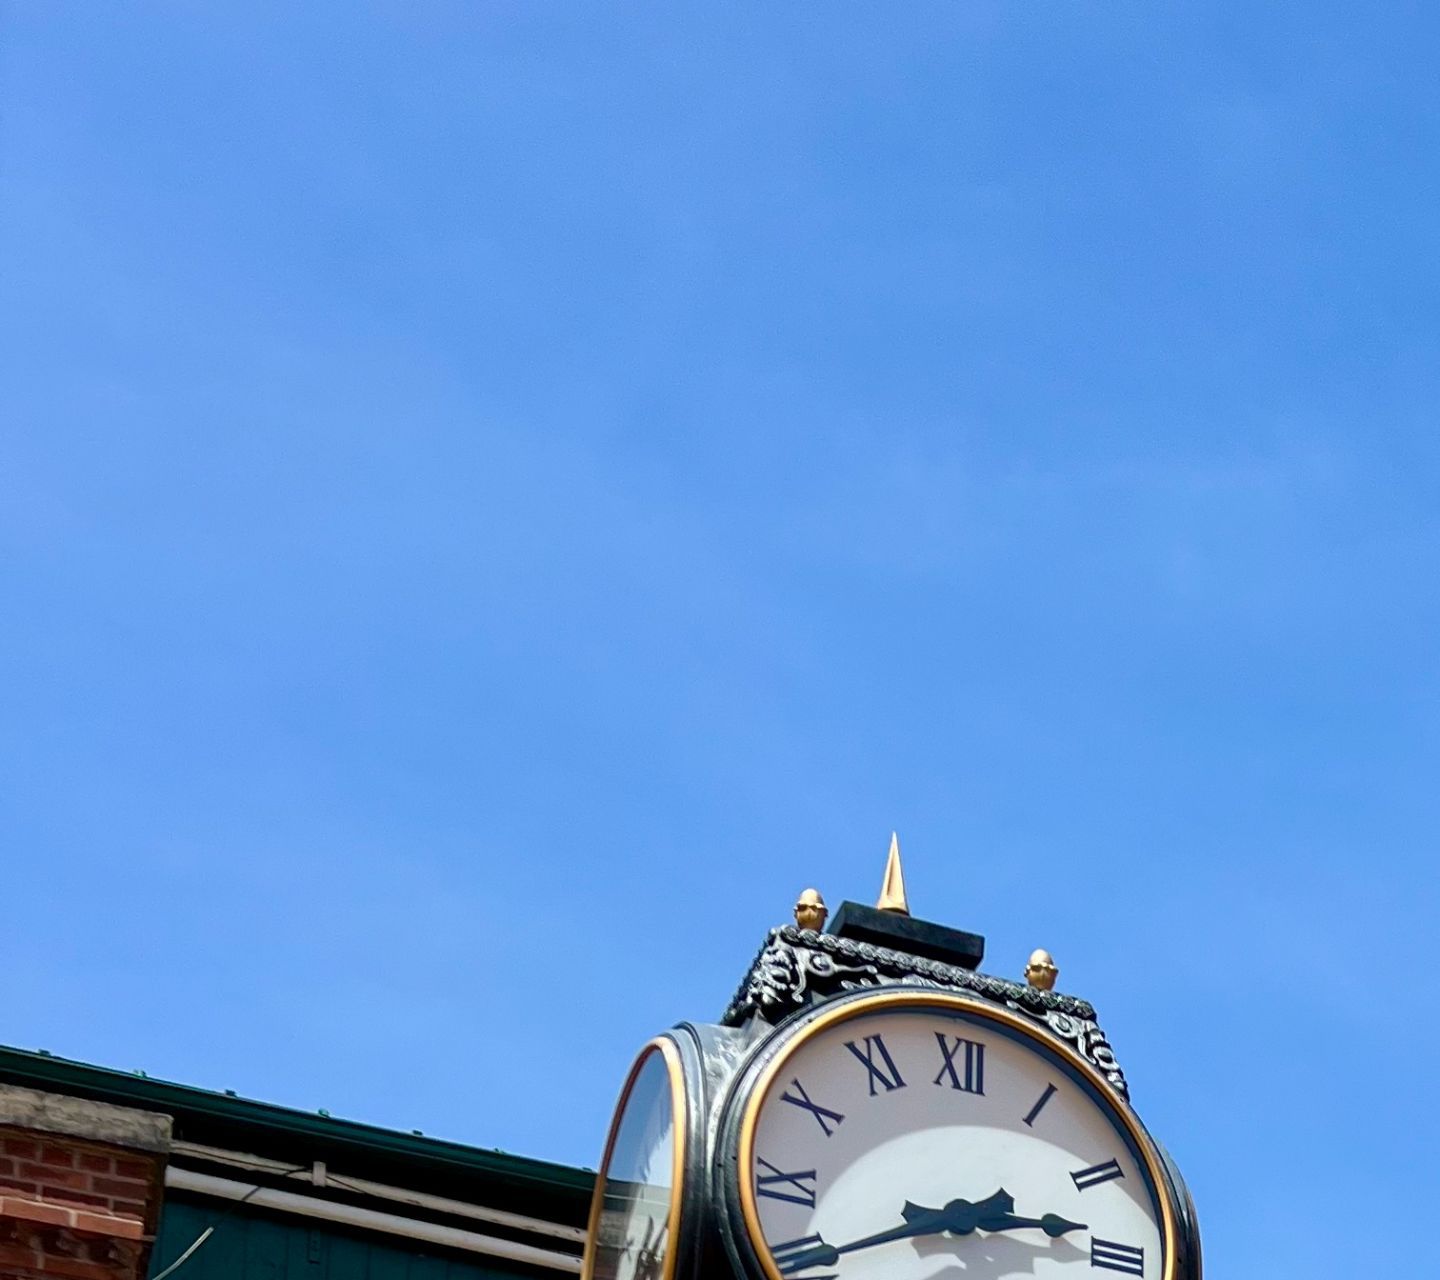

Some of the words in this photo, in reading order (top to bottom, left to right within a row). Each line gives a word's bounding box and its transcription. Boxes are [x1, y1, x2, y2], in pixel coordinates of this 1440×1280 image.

[932, 1032, 986, 1097] XII
[779, 1078, 846, 1138] X
[1091, 1236, 1145, 1279] III
